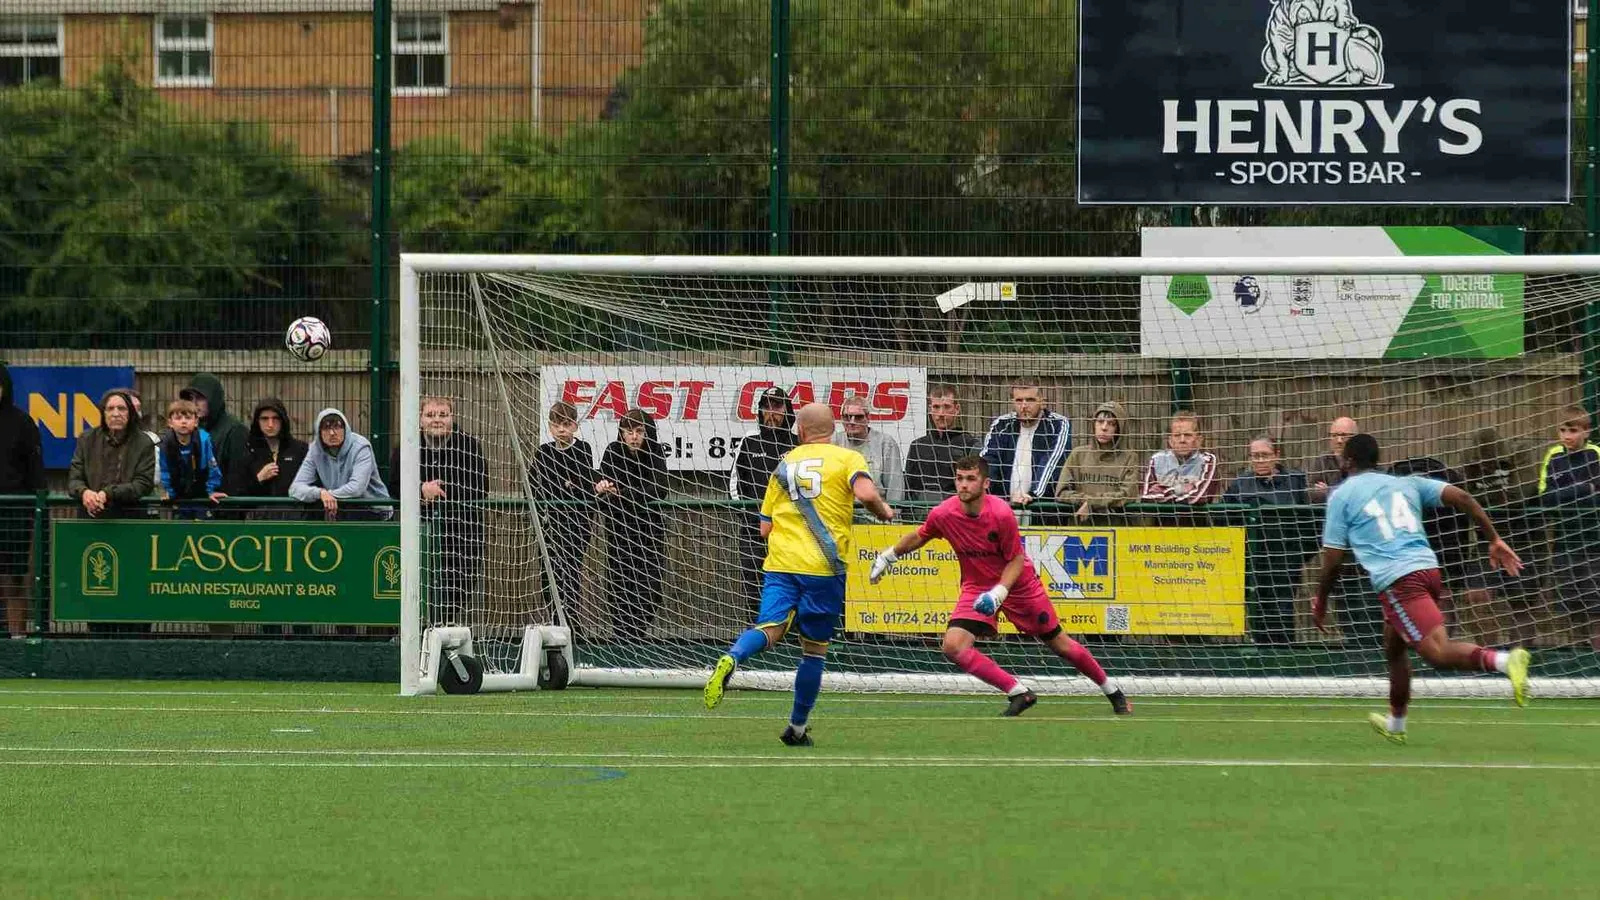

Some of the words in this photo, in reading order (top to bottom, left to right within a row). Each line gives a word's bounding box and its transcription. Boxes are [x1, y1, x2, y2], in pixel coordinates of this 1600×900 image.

[1307, 32, 1338, 66] H
[1162, 97, 1483, 155] HENRY'S
[1441, 275, 1494, 291] TOGETHER
[1431, 293, 1451, 309] FOR
[1454, 292, 1504, 309] FOOTBALL
[561, 381, 714, 421] FAST
[786, 459, 823, 501] 15
[1364, 492, 1418, 540] 14
[150, 534, 343, 573] LASCITO
[1129, 544, 1151, 553] MKM
[1154, 545, 1190, 555] Building
[1193, 545, 1231, 555] Supplies
[1197, 561, 1216, 571] Way
[150, 583, 200, 595] ITALIAN
[203, 583, 293, 596] RESTAURANT
[295, 584, 305, 596] &
[308, 584, 336, 596] BAR
[1048, 582, 1104, 593] SUPPLIES
[1154, 576, 1207, 587] Scunthorpe
[229, 599, 260, 610] BRIGG
[859, 612, 878, 624] Tel:
[883, 612, 919, 624] 01724
